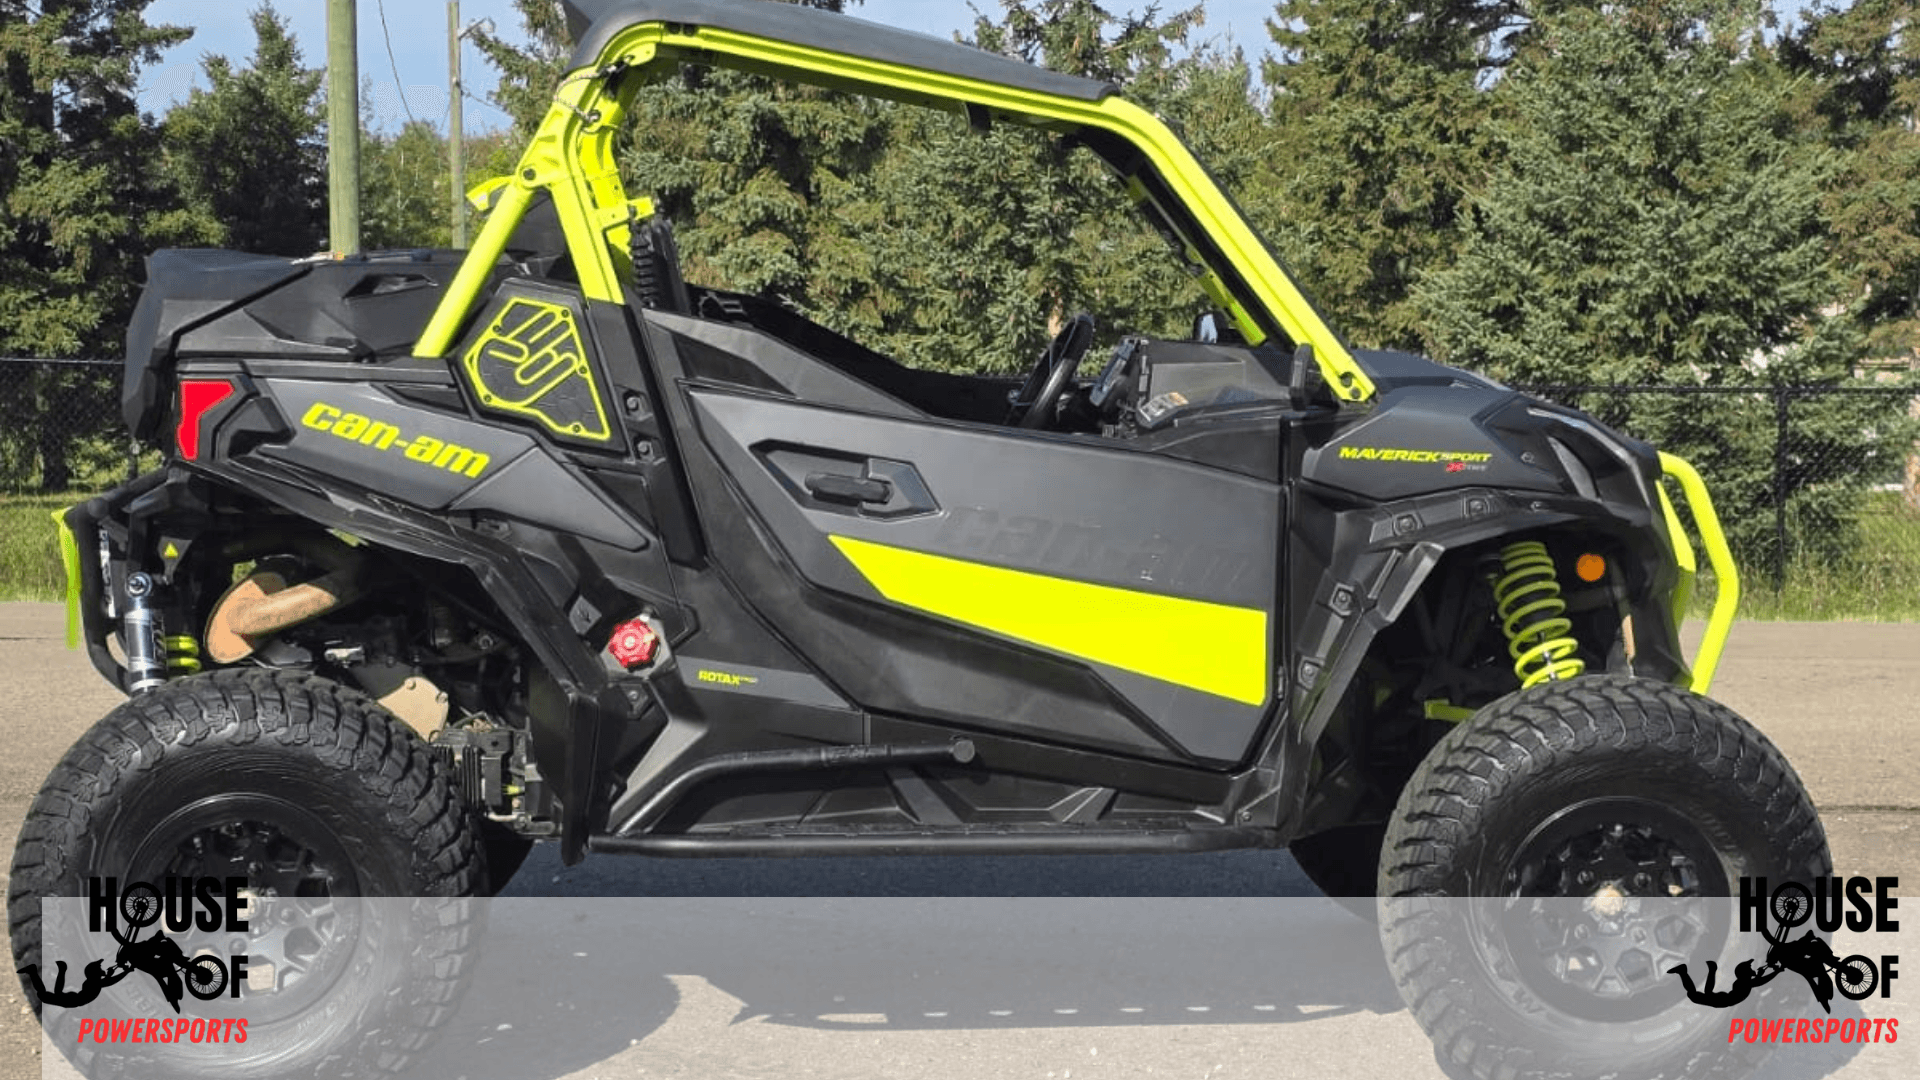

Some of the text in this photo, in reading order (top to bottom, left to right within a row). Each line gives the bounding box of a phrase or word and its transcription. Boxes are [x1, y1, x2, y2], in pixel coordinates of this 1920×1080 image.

[301, 402, 490, 478] can-am
[1339, 446, 1441, 462] MAVERICK
[698, 670, 744, 686] ROTAX
